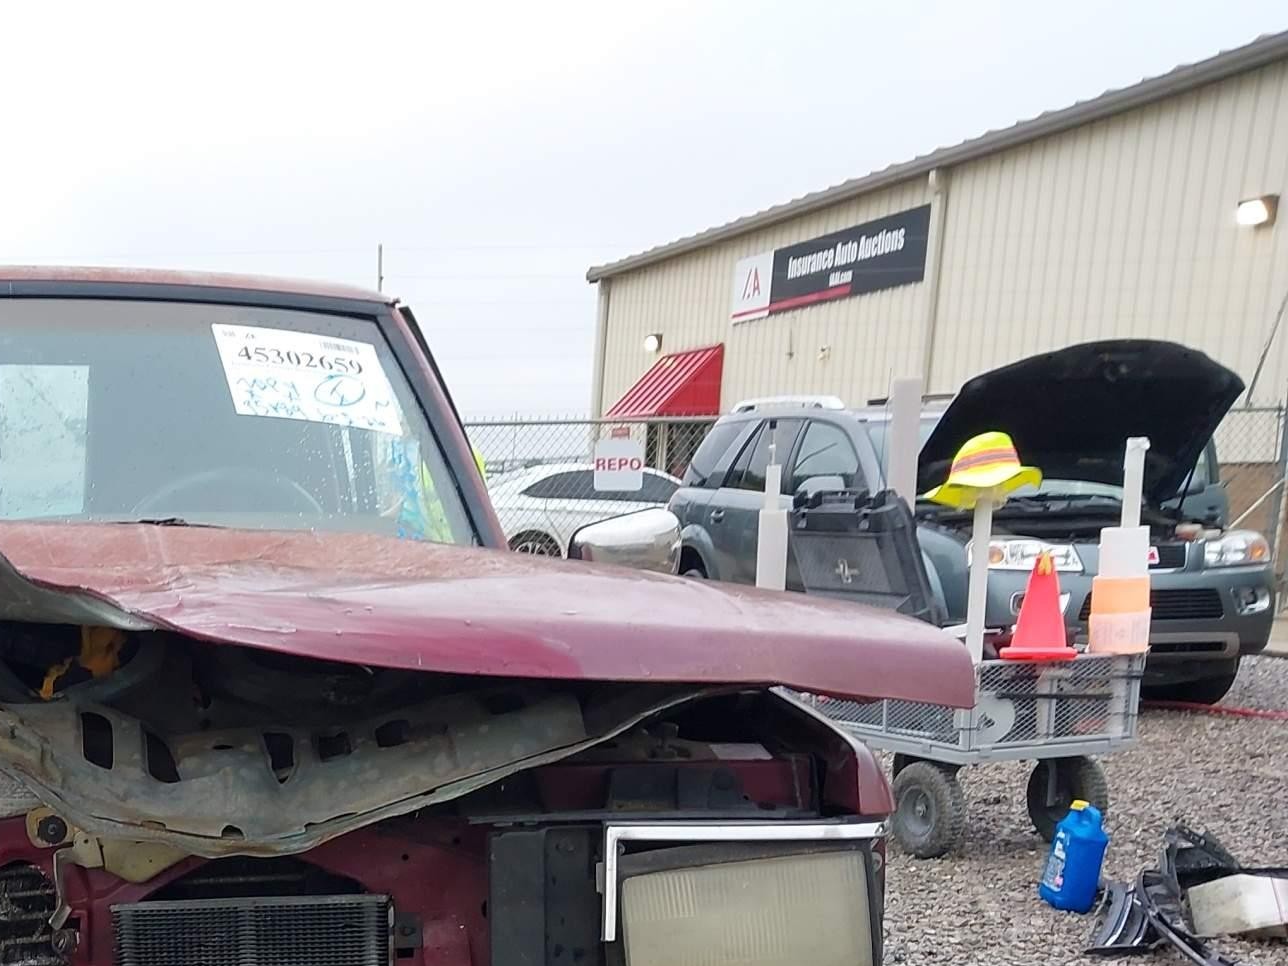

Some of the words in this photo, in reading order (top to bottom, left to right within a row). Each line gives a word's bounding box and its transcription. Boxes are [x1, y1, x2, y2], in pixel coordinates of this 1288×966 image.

[787, 247, 835, 281] Insurance
[834, 240, 858, 267] Auto
[857, 227, 905, 262] Auctions
[237, 345, 363, 375] 45302659
[595, 457, 642, 471] REPO
